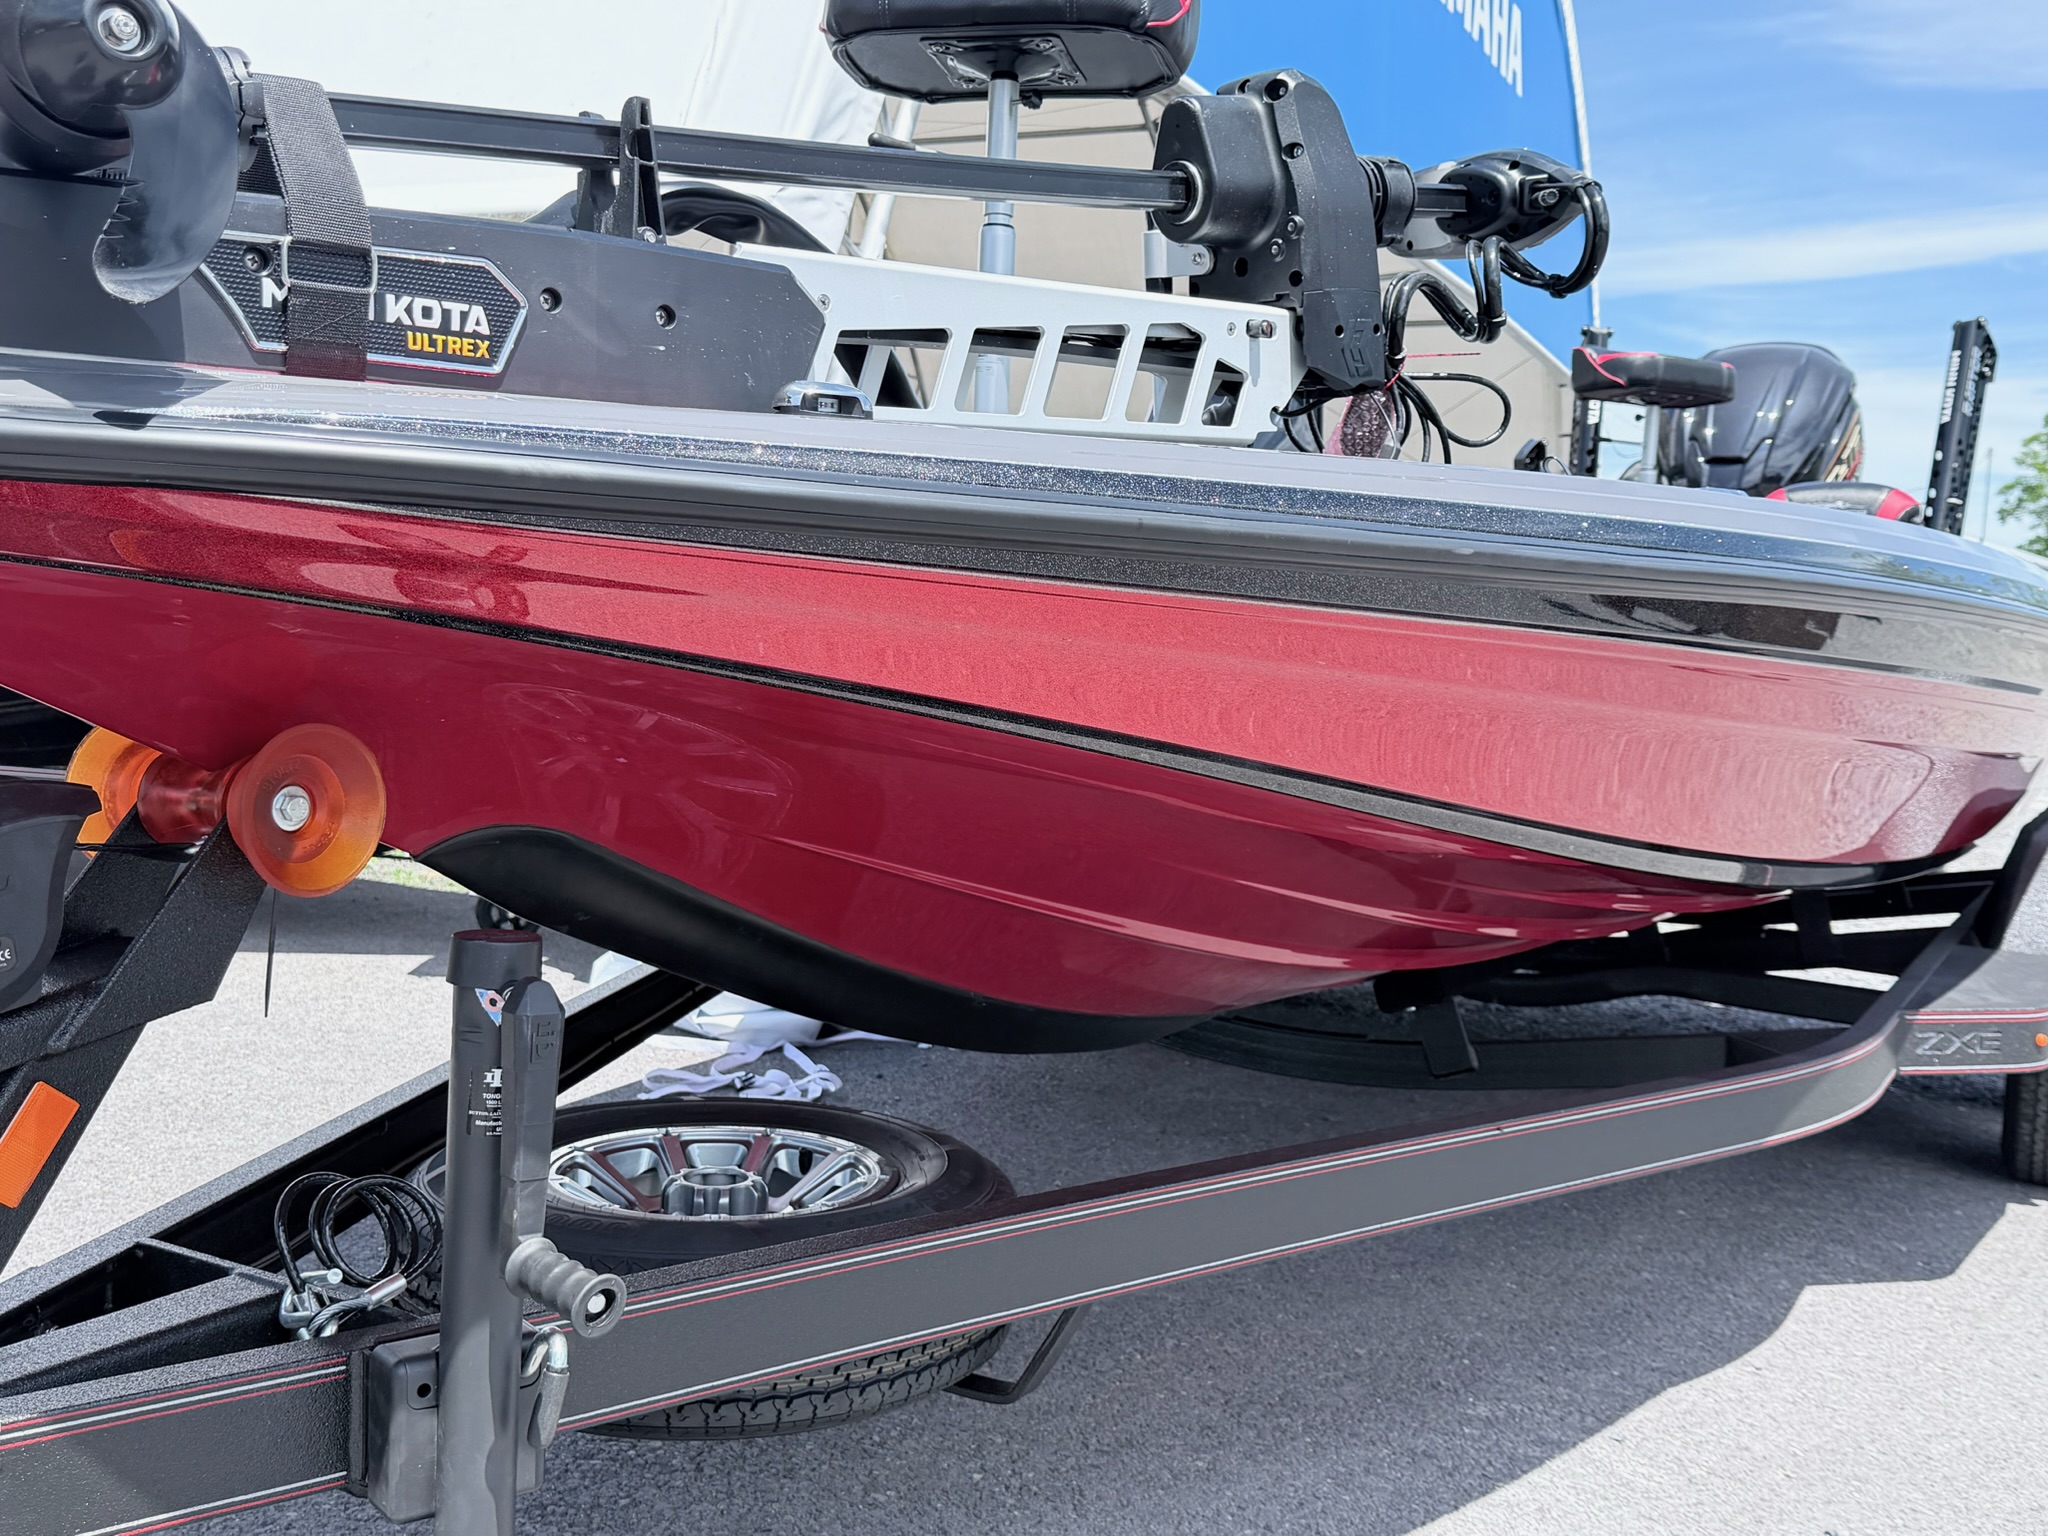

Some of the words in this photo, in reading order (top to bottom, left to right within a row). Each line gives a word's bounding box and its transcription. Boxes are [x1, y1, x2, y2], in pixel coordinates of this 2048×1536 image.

[385, 293, 491, 335] KOTA
[406, 331, 491, 359] ULTREX
[1915, 1031, 2002, 1055] ZXE
